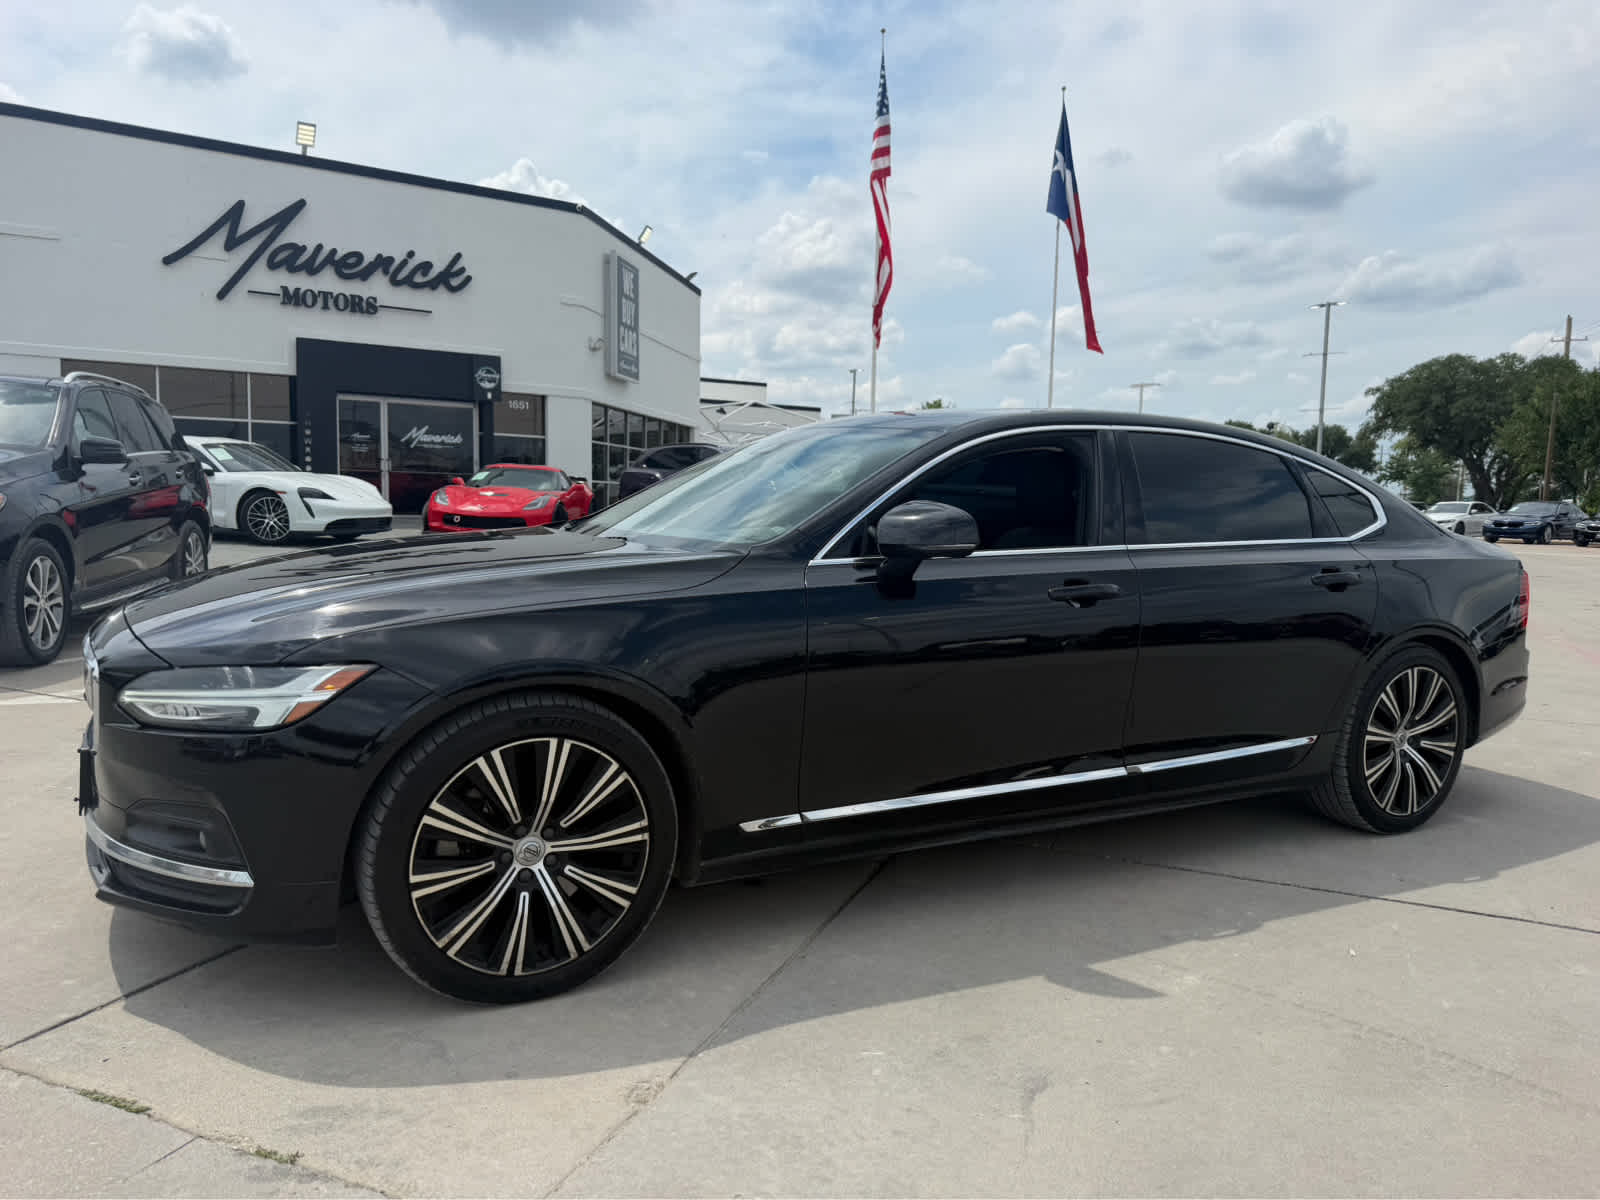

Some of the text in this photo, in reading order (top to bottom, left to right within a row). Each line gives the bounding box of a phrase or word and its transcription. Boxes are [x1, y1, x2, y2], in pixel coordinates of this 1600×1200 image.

[162, 198, 472, 300] Maverick
[280, 285, 379, 314] MOTORS
[400, 424, 463, 448] Maverick
